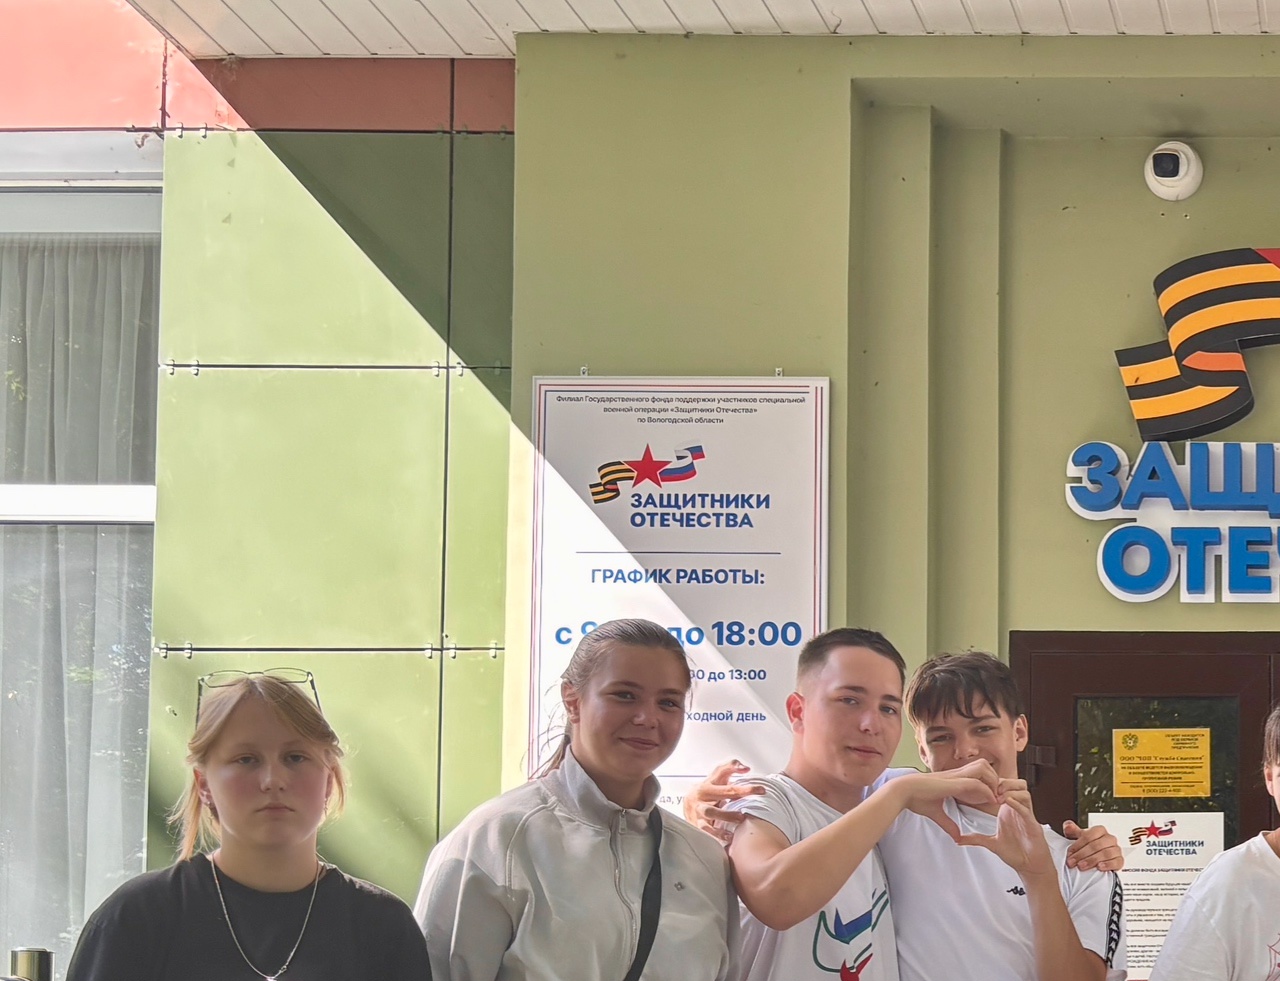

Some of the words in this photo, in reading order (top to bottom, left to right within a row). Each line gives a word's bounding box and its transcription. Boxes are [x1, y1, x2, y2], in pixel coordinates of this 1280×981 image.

[630, 493, 770, 510] ЗАЩИТНИКИ
[630, 512, 754, 528] ОТЕЧЕСТВА
[591, 568, 671, 584] ГРАФИК
[676, 569, 765, 584] РАБОТЫ:
[555, 627, 572, 645] с
[711, 620, 802, 647] 18:00
[707, 671, 726, 682] до
[728, 669, 767, 680] 13:00
[686, 710, 734, 722] ХОДНОЙ
[736, 712, 767, 722] ДЕНЬ
[1146, 840, 1204, 848] ЗАЩИТНИКИ
